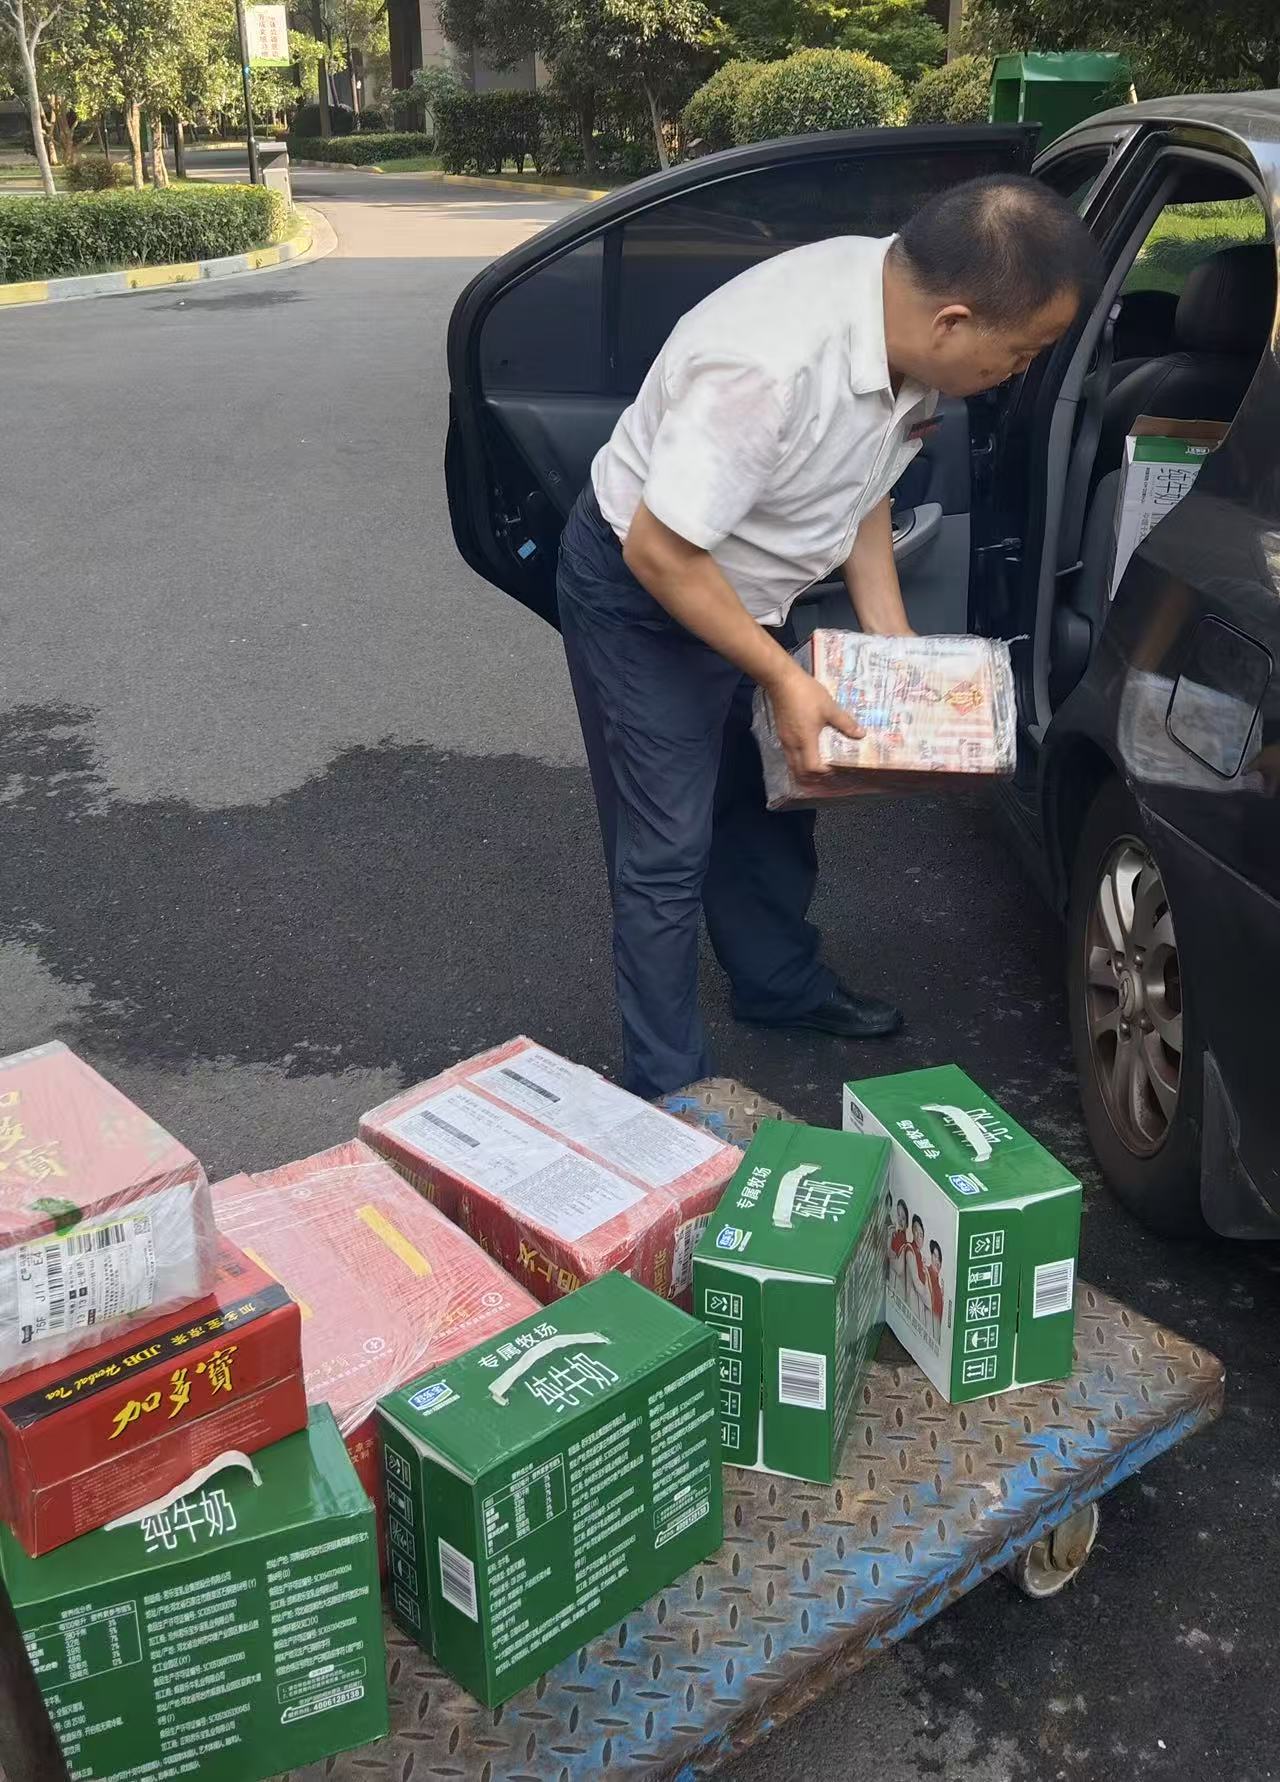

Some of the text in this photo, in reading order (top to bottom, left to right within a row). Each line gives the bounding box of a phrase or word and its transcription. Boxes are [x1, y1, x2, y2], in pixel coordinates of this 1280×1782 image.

[736, 1166, 772, 1209] 专属牧场
[121, 1343, 162, 1369] JDB
[477, 1321, 559, 1370] 专属牧场
[45, 1388, 73, 1401] Tea
[74, 1364, 121, 1391] Herbal
[524, 1352, 621, 1414] 纯牛奶
[139, 1488, 237, 1554] 纯牛奶
